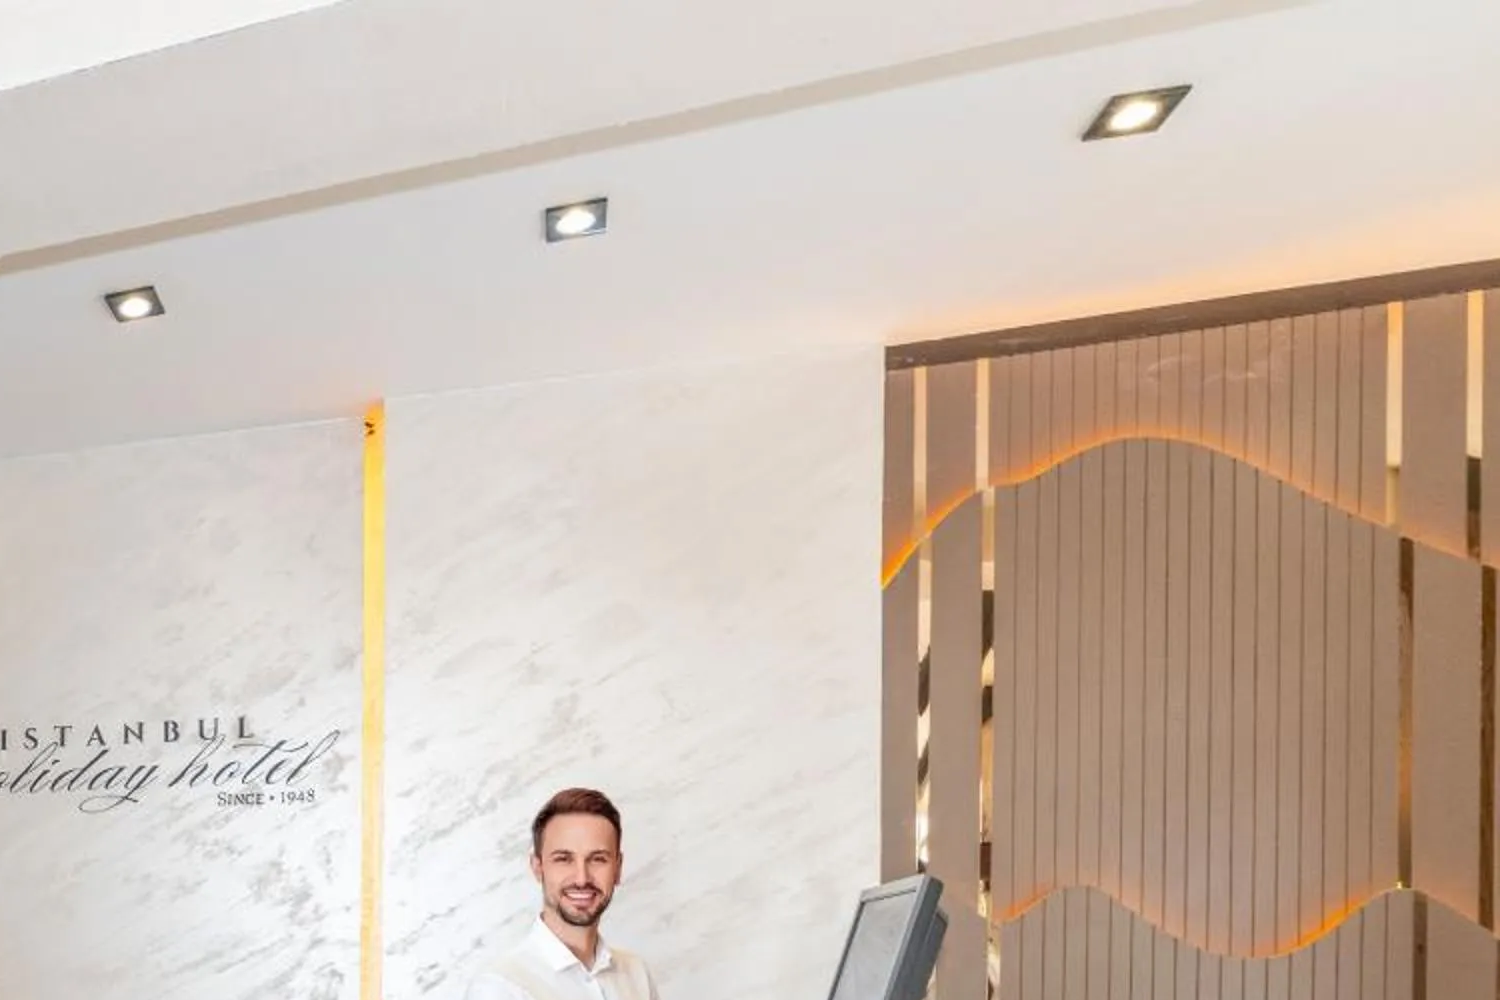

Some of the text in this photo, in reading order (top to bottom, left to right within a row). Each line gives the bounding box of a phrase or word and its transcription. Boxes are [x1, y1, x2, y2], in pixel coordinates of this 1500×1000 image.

[0, 715, 255, 751] ISTANBUL
[167, 730, 341, 788] hotel
[280, 787, 315, 805] 1948
